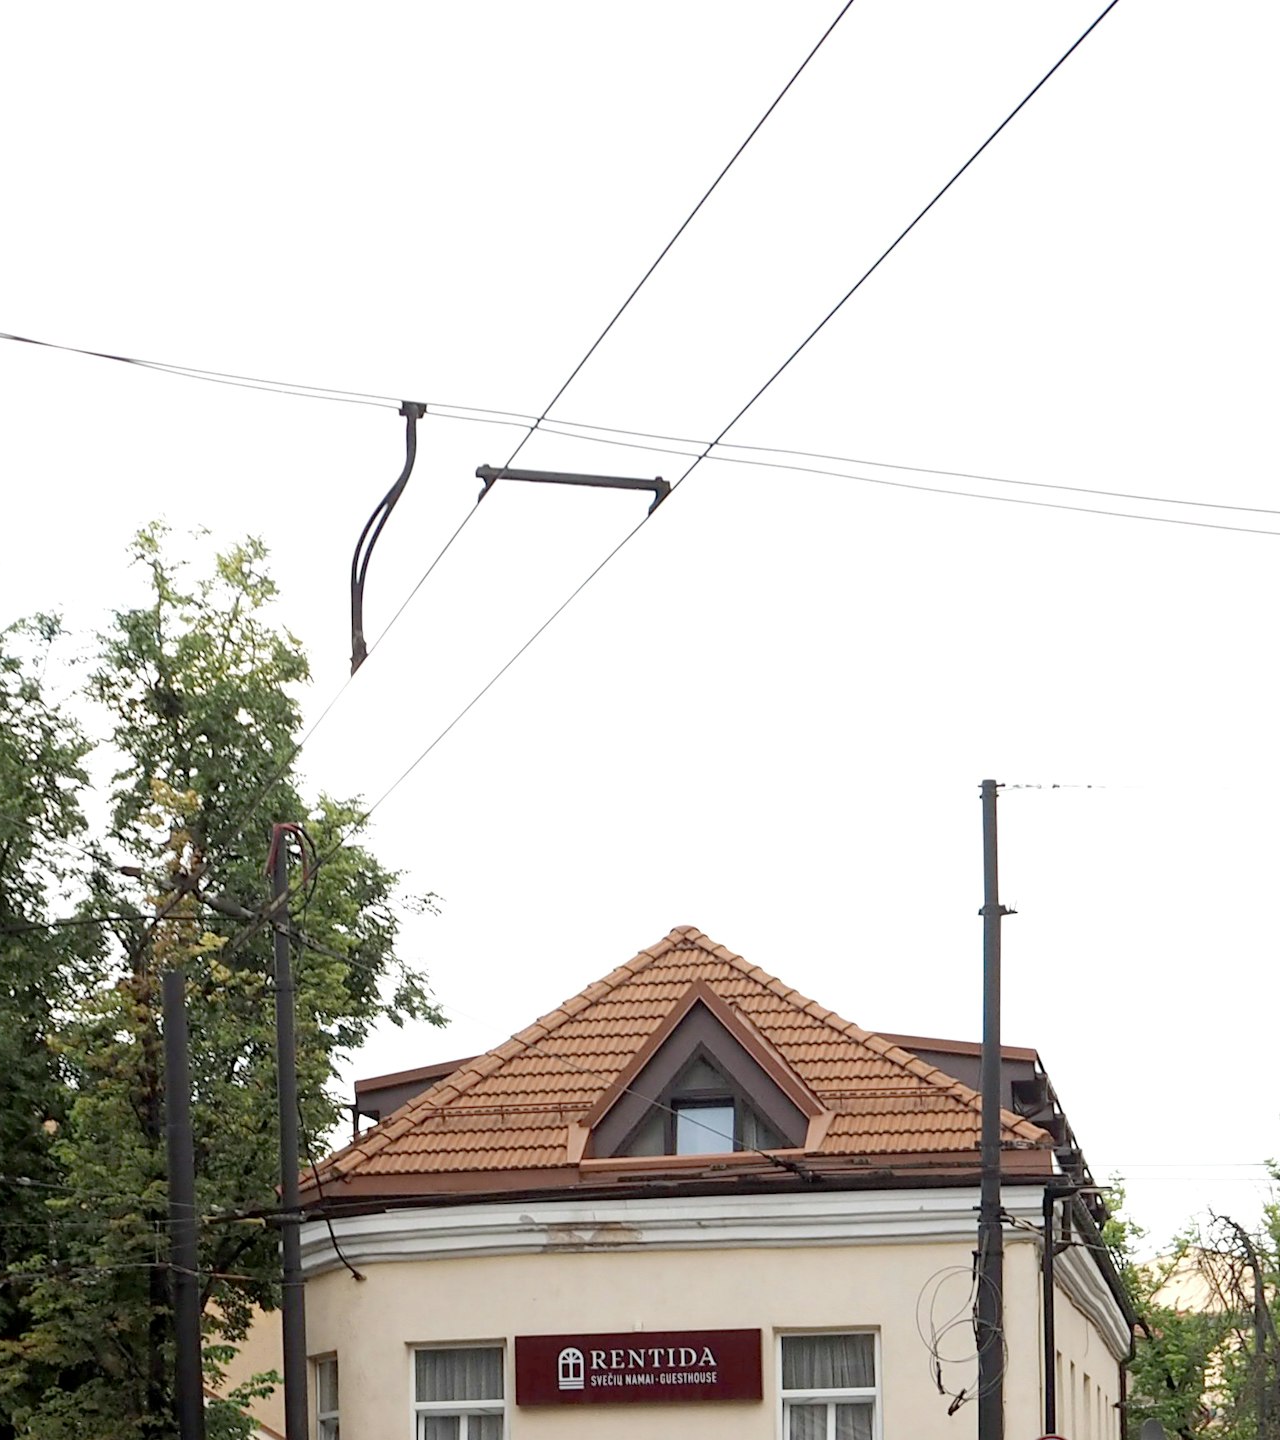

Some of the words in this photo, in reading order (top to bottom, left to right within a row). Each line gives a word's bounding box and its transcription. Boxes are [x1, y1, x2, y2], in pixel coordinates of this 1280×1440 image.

[590, 1346, 718, 1370] RENTIDA
[625, 1373, 655, 1386] NAMAI
[659, 1371, 718, 1385] GUESTHOUSE
